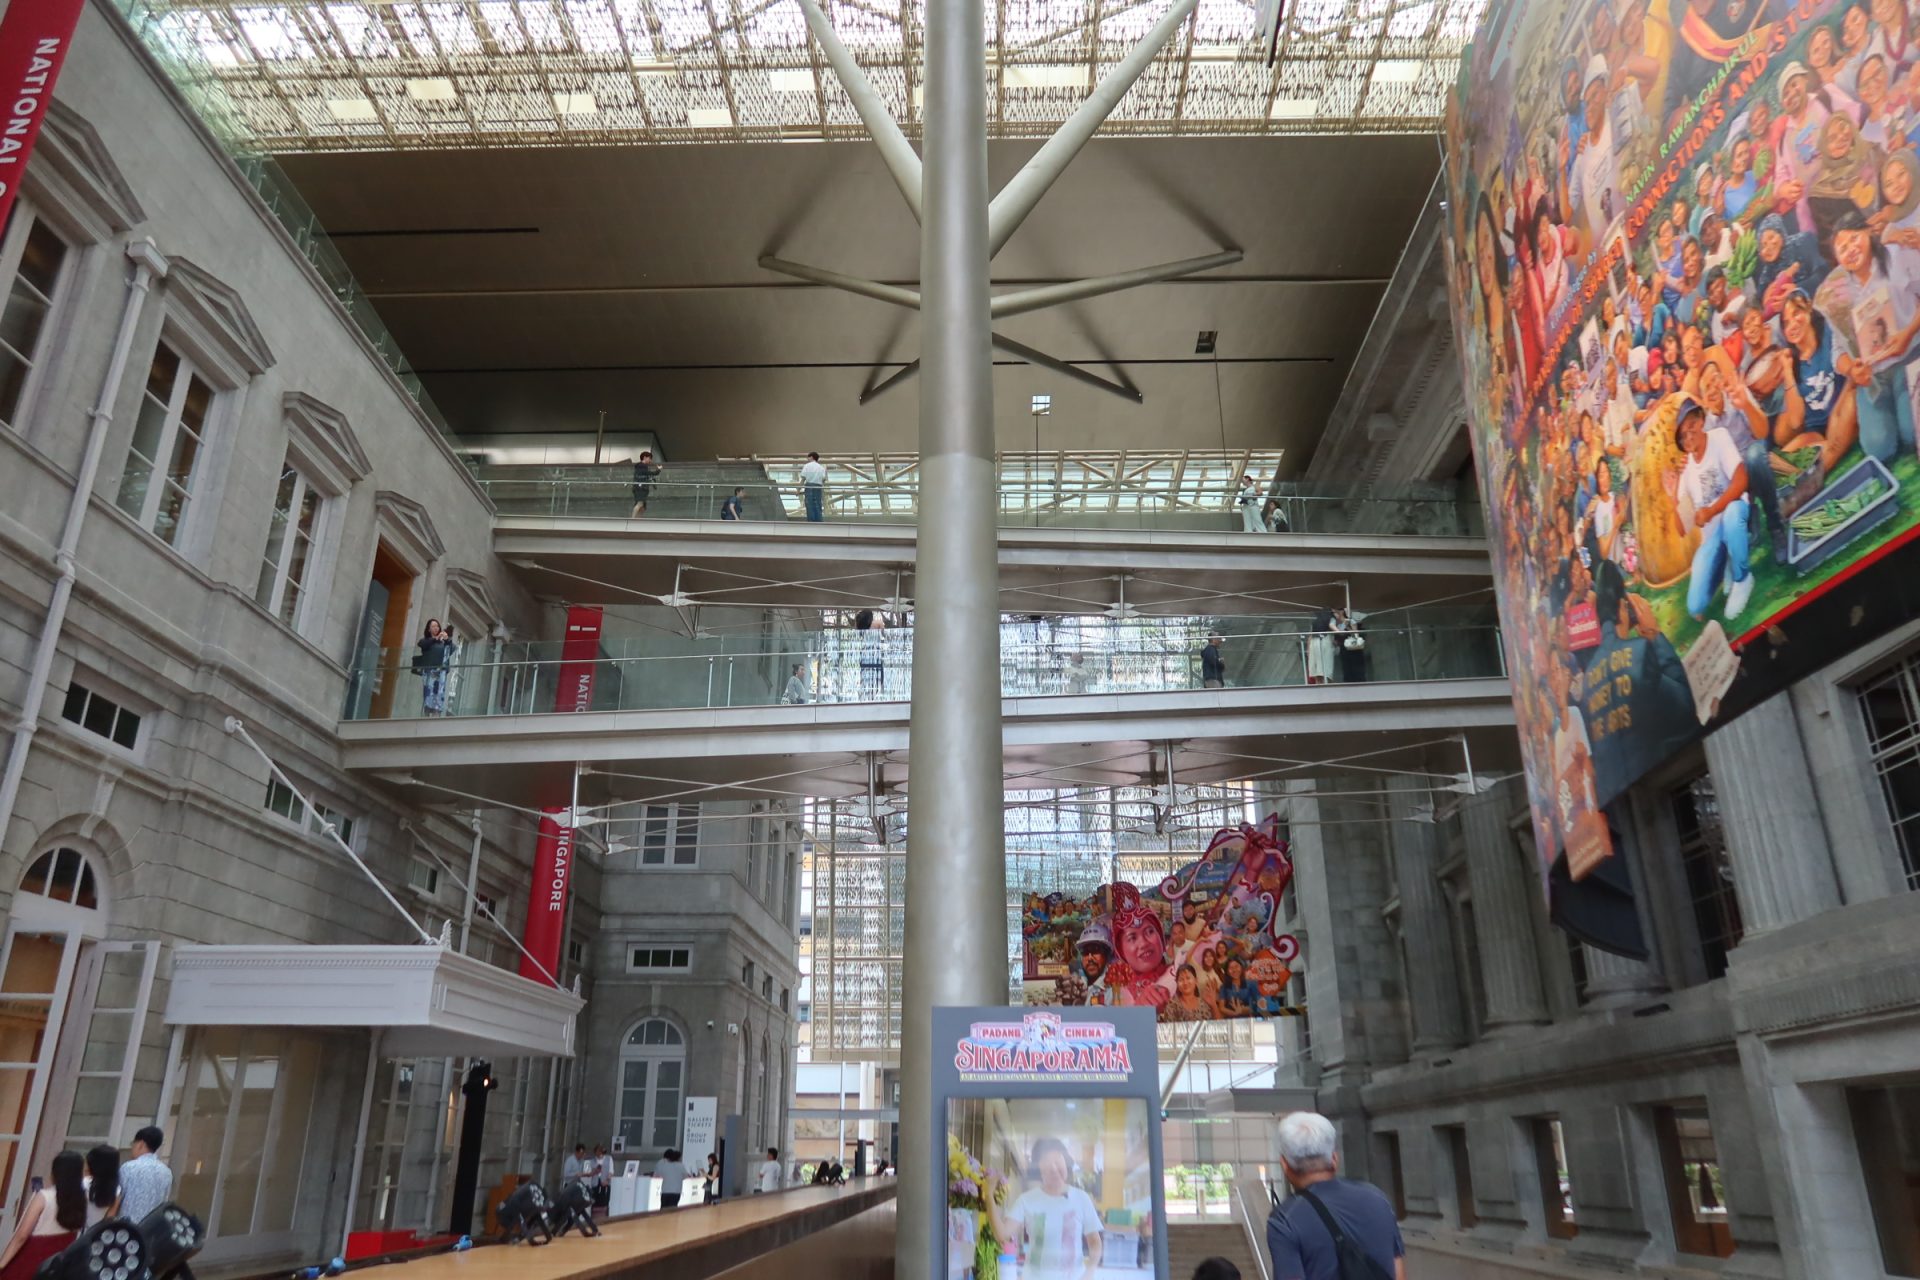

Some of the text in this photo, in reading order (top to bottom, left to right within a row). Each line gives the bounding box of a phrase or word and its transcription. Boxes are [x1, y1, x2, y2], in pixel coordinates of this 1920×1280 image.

[1624, 100, 1726, 240] CONNECTIONS
[1728, 49, 1768, 107] AND
[1626, 160, 1655, 206] NAVIN
[576, 674, 590, 712] NATIO
[550, 826, 570, 911] INGAPORE
[982, 1027, 1102, 1038] PADANG CINEMA
[956, 1039, 1131, 1072] SINGAPORAMA
